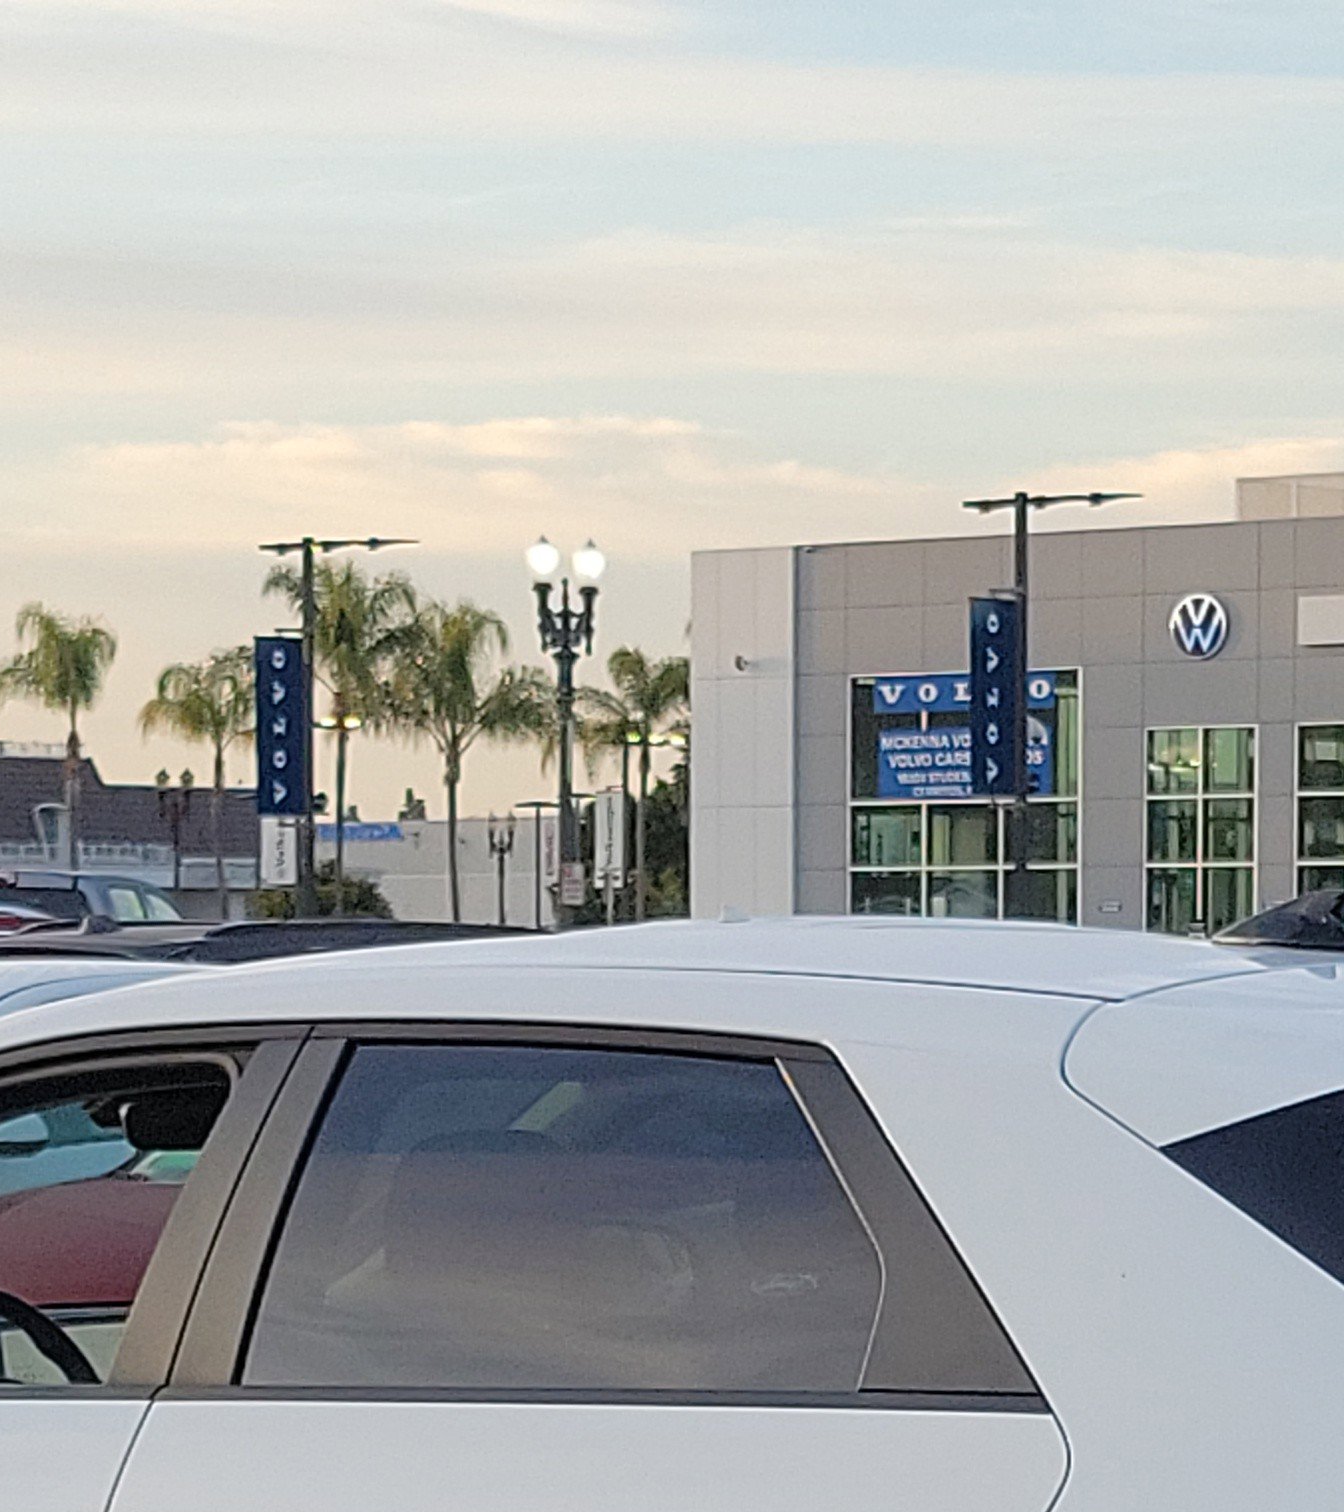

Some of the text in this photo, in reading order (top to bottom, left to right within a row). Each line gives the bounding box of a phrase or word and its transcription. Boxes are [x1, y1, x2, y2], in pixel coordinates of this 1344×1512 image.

[271, 650, 288, 806] VOLVO
[877, 678, 1051, 704] VOLO
[985, 612, 1000, 785] VOLVO
[887, 753, 932, 769] VOLVO
